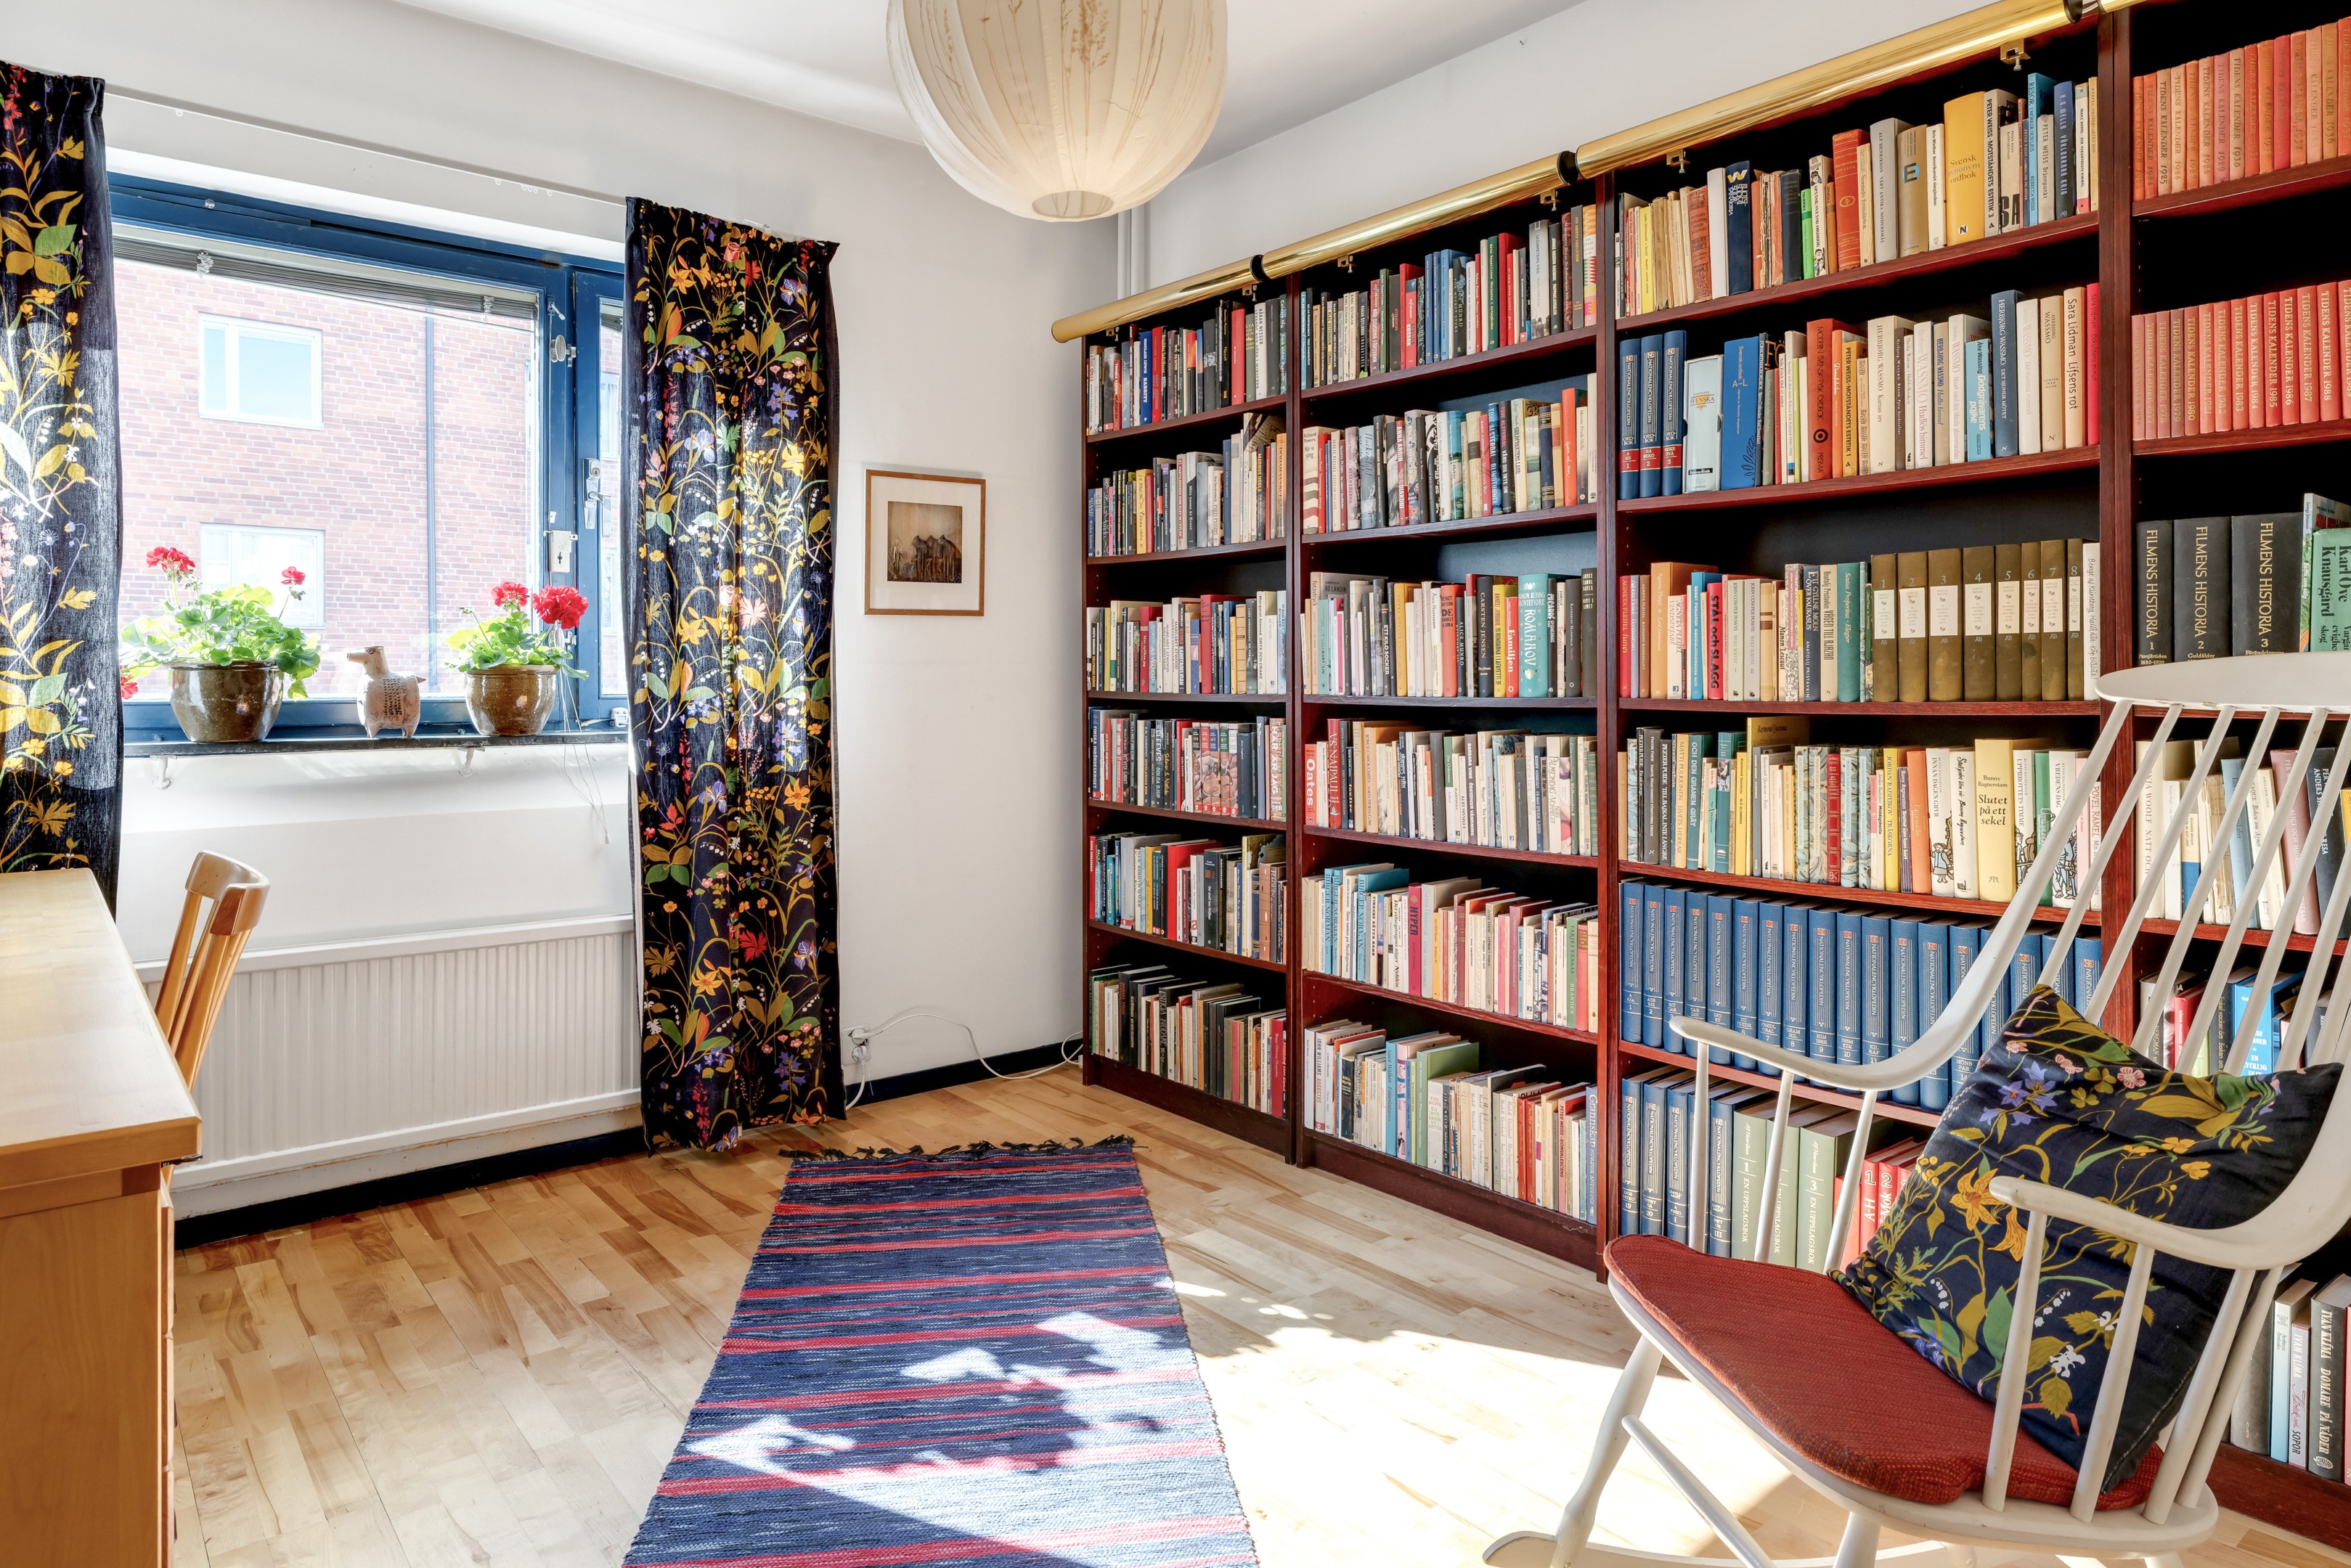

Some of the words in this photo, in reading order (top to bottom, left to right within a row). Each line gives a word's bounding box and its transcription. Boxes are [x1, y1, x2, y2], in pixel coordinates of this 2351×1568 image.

[1948, 163, 1980, 176] synonym
[1950, 155, 1976, 168] Svensk
[1950, 172, 1976, 184] ordbok
[2068, 299, 2077, 319] Sara
[2302, 293, 2311, 327] TIDENS
[2268, 334, 2277, 385] KALENDER
[2302, 330, 2312, 380] KALENDER
[2322, 326, 2331, 379] KALENDER
[1978, 375, 1987, 430] Dödgrävarens
[2146, 530, 2157, 579] FILMENS
[2196, 526, 2207, 577] FILMENS
[2260, 523, 2273, 574] FILMENS
[2339, 546, 2351, 574] Karl
[1822, 571, 1831, 587] Anatolij
[1941, 576, 1947, 584] 3
[1975, 573, 1981, 581] 4
[2005, 571, 2011, 580] 5
[2028, 570, 2034, 579] 6
[2049, 568, 2056, 576] 7
[2071, 566, 2077, 575] 8
[1909, 578, 1915, 587] 2
[2318, 546, 2336, 616] Knausgård
[2339, 577, 2351, 602] Ove
[1710, 595, 1722, 624] STÅL
[2146, 584, 2157, 638] HISTORIA
[2195, 581, 2207, 637] HISTORIA
[2258, 579, 2273, 635] HISTORIA
[1824, 611, 1835, 626] VÄGEN
[1524, 609, 1536, 666] ROMANOV
[1711, 626, 1719, 647] och
[1824, 629, 1833, 639] TILL
[2261, 639, 2268, 648] 3
[2319, 625, 2328, 643] skog
[1824, 640, 1833, 660] RJAZAN
[2198, 640, 2204, 649] 2
[1271, 755, 1279, 770] ÄR
[1329, 750, 1338, 794] NAIPAUL
[1979, 794, 2008, 804] Slutet
[1980, 807, 1990, 817] på
[1588, 1095, 1597, 1147] Grannskap
[1743, 1178, 1749, 1189] EN
[1865, 1171, 1875, 1185] 1
[1882, 1173, 1892, 1187] 2
[1810, 1197, 1816, 1208] EN
[1865, 1198, 1875, 1222] A-H
[2321, 1310, 2332, 1332] IVAN
[2321, 1333, 2333, 1358] KLÍMA
[2320, 1368, 2331, 1408] DOMARE
[2320, 1410, 2331, 1423] PÅ
[2292, 1430, 2301, 1454] SOPOR
[2318, 1423, 2332, 1454] NÅDER
